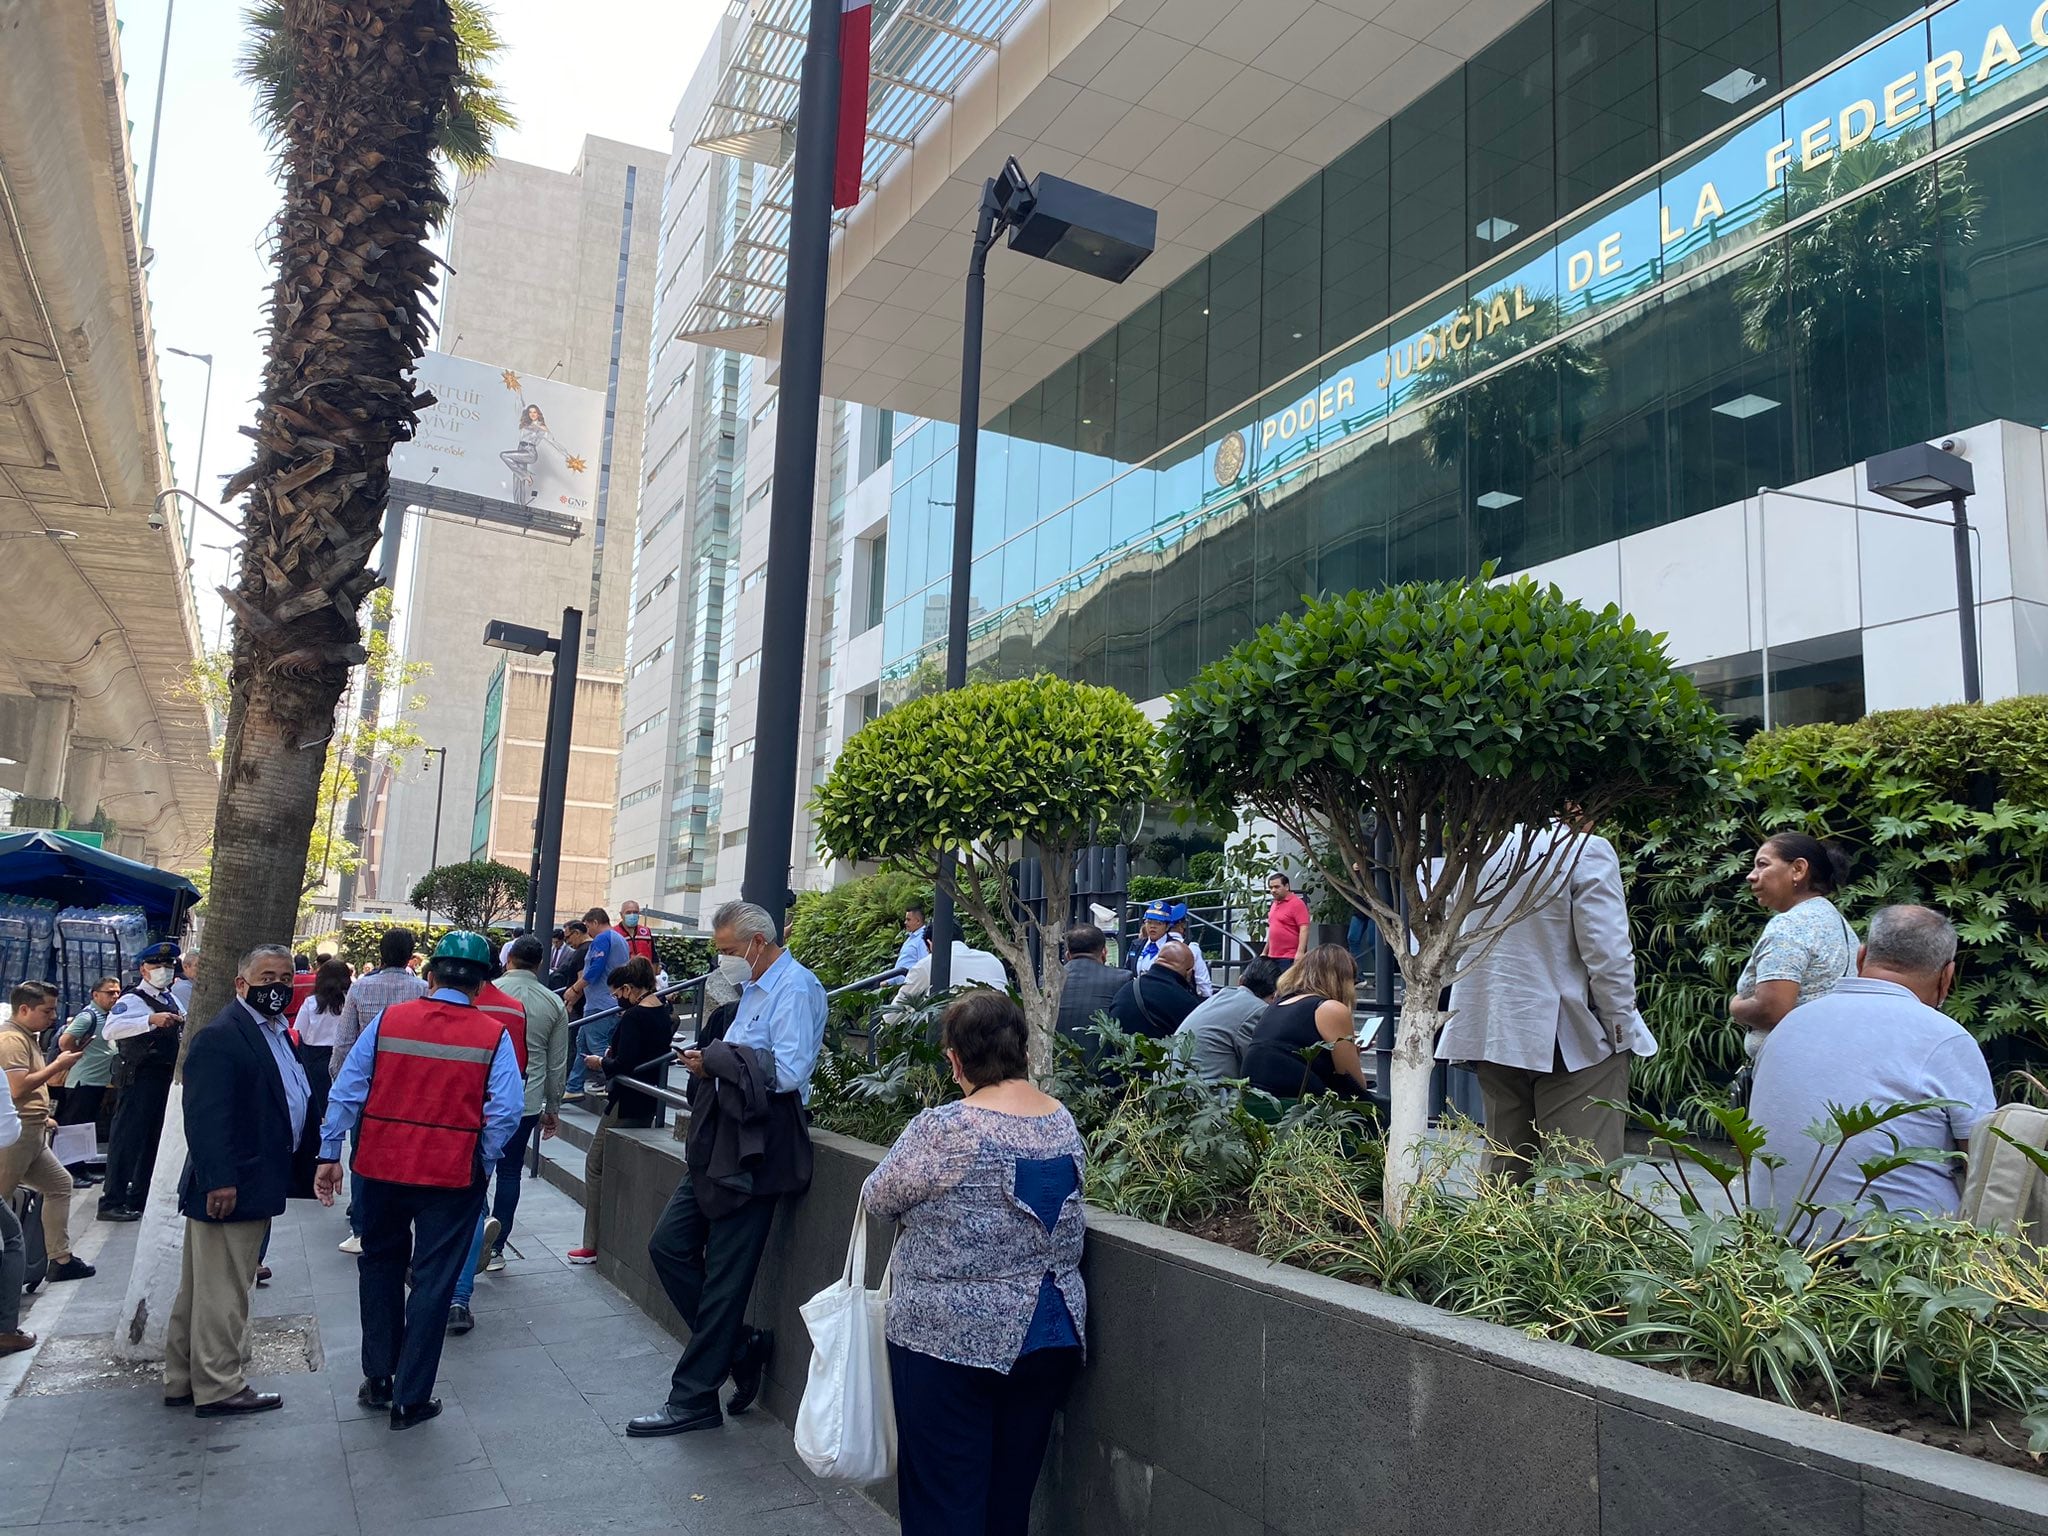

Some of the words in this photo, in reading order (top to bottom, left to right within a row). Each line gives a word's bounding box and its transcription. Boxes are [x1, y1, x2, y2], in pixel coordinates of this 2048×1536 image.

[1261, 376, 1356, 450] PODER
[1376, 284, 1537, 389] JUDICIAL
[1568, 231, 1624, 292] DE
[1660, 181, 1726, 245] LA
[417, 379, 485, 405] nstruir
[427, 402, 481, 422] eños
[568, 497, 588, 508] GNP
